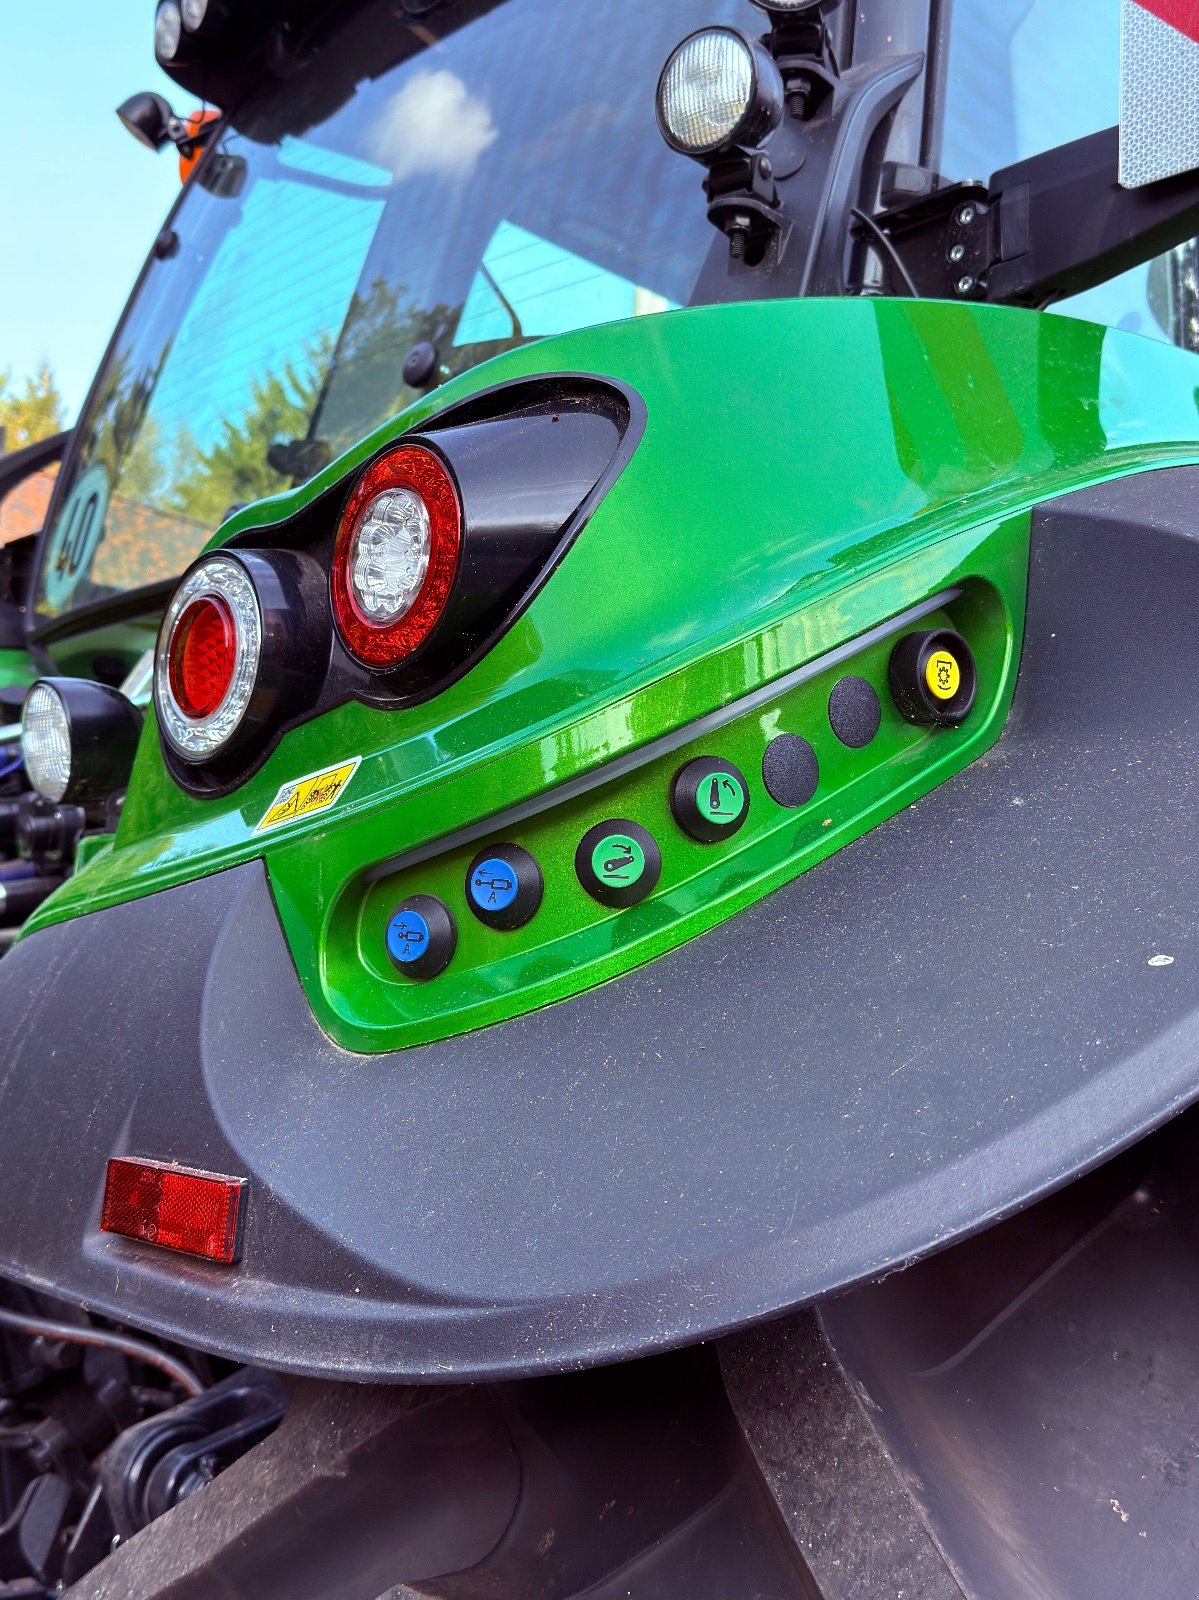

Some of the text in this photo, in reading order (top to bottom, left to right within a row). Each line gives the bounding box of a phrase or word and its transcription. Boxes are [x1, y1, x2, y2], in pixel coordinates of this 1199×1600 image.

[56, 491, 99, 583] 40
[487, 890, 497, 904] A
[402, 943, 411, 956] A
